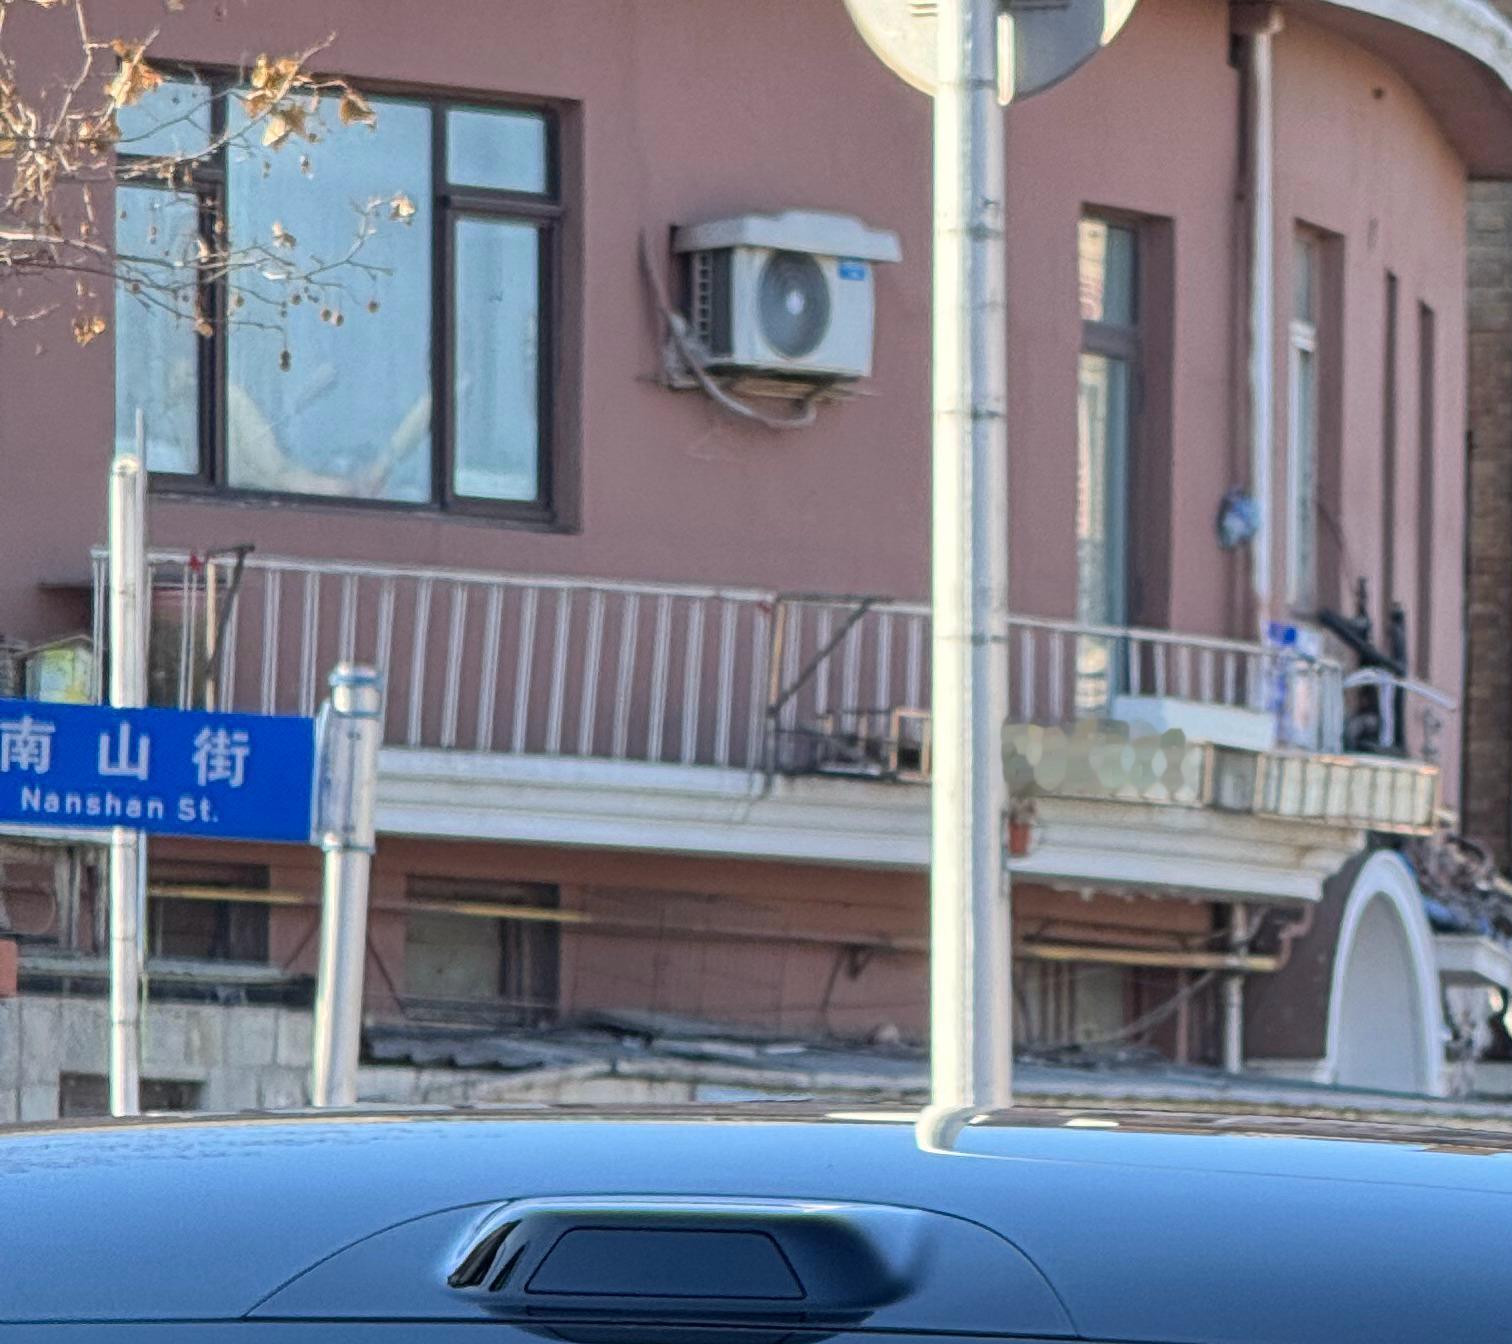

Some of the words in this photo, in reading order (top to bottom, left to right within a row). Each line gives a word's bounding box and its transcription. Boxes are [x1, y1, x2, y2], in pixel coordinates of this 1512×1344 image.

[0, 715, 250, 788] 南山街
[21, 785, 164, 820] Nanshan
[177, 795, 219, 823] St.
